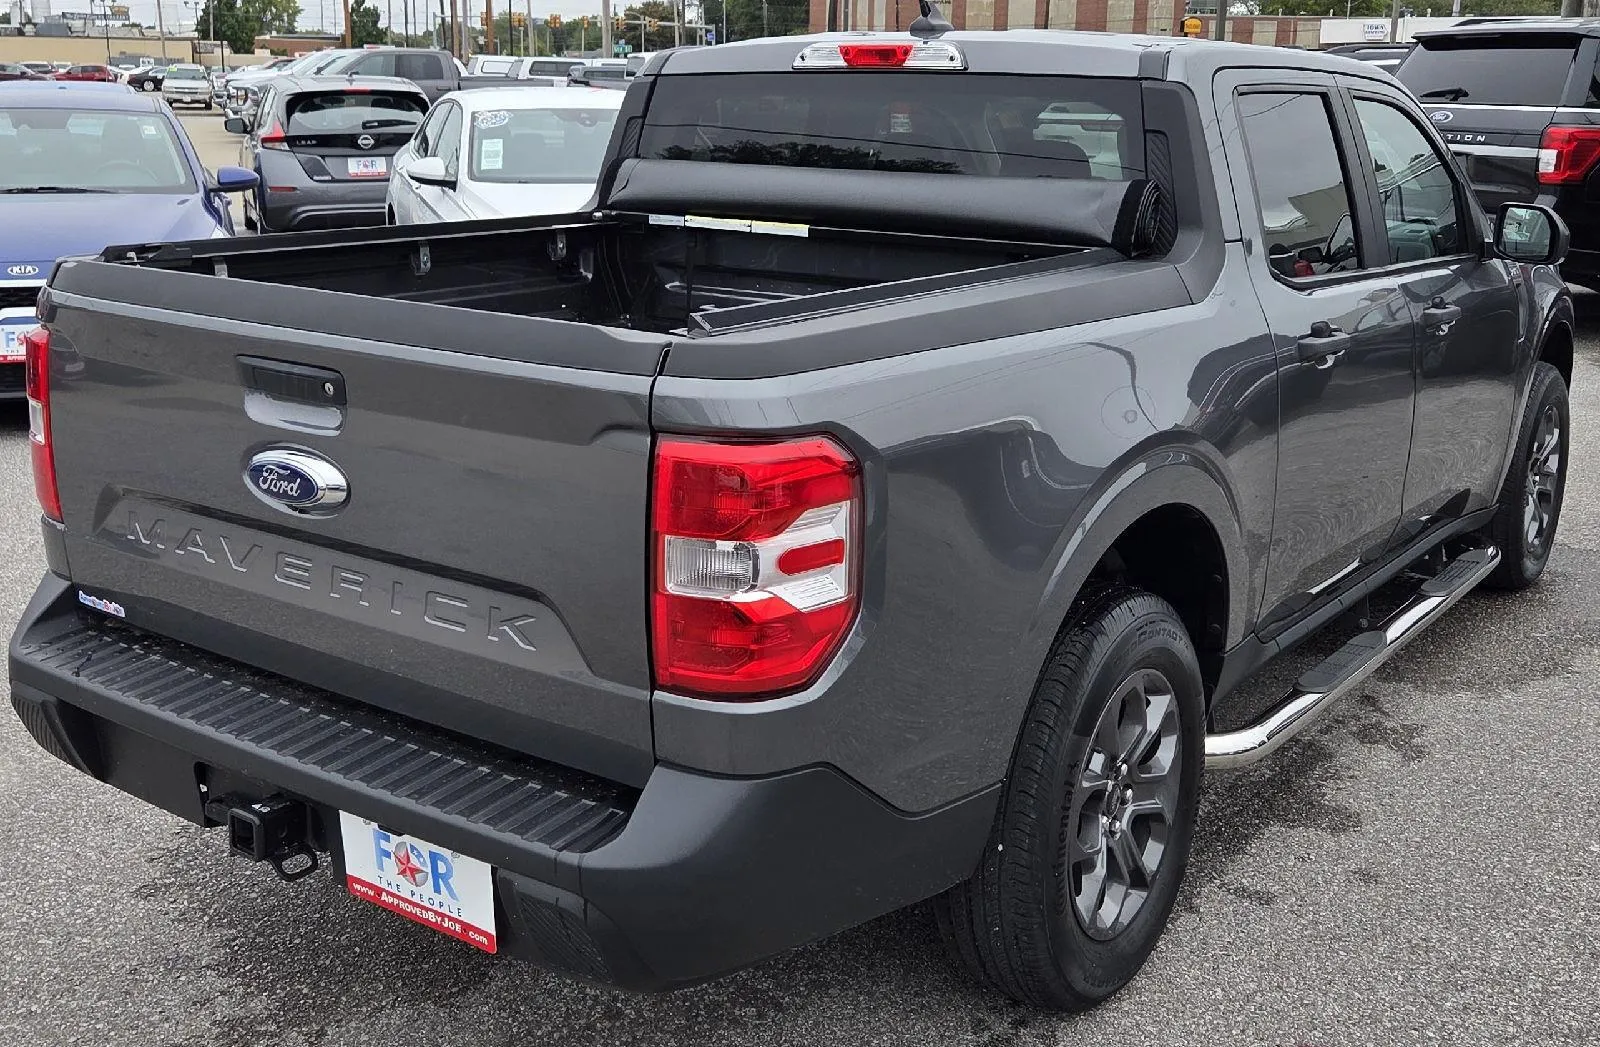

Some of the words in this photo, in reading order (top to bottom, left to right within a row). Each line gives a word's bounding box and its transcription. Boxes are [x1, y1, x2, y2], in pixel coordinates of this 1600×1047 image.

[1441, 133, 1486, 142] TION
[12, 265, 34, 273] KIA
[258, 464, 301, 497] Ford
[127, 510, 537, 651] MAVERICK
[372, 827, 460, 902] FOR
[377, 875, 401, 893] THE
[410, 889, 462, 918] PEOPLE
